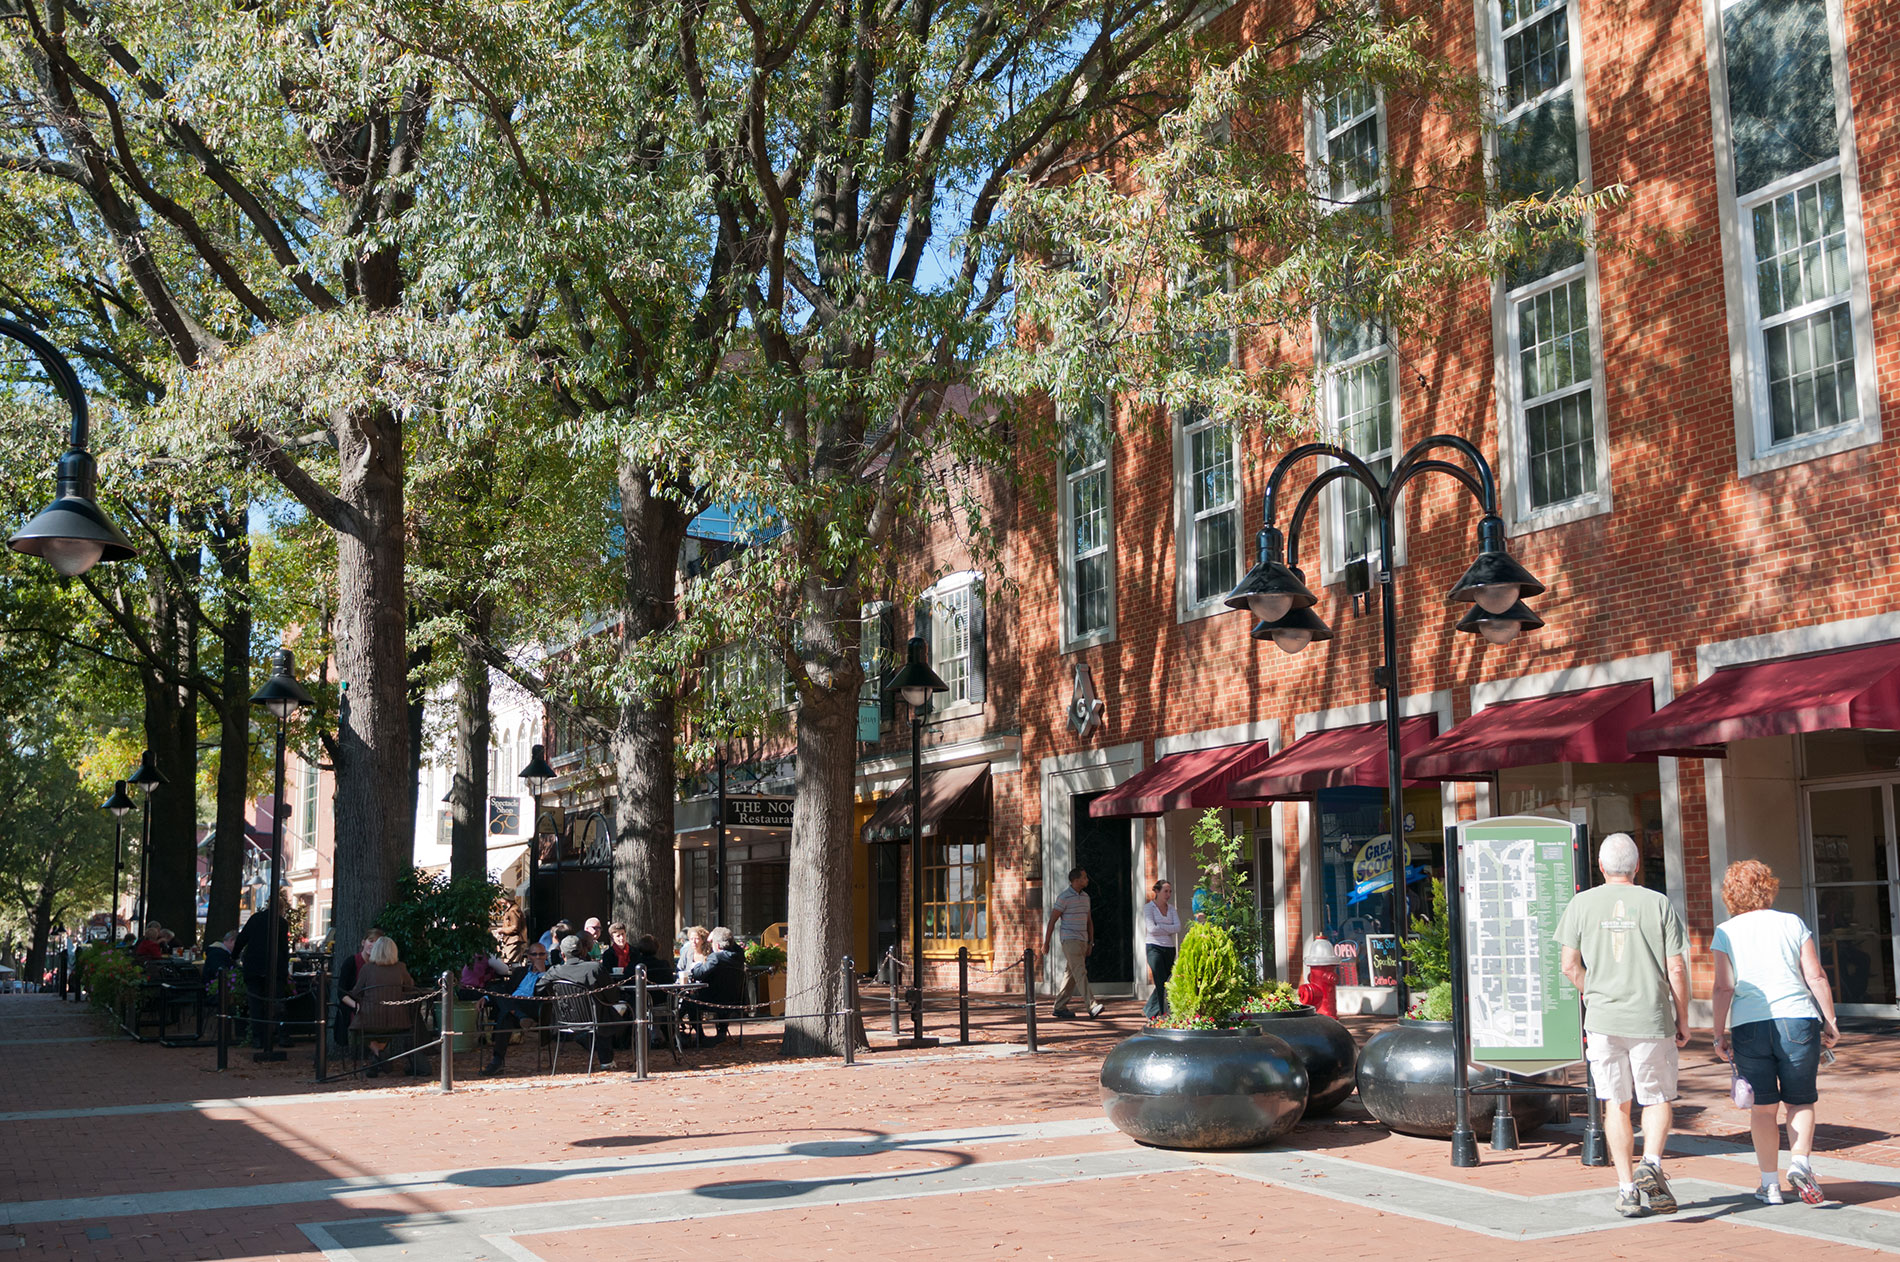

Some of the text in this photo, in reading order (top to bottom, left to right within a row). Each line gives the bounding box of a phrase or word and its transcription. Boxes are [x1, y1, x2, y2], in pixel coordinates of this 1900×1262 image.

[490, 797, 519, 808] Spectacle
[732, 801, 795, 814] THE NO
[496, 804, 514, 815] Shop
[739, 812, 794, 824] Restaura
[1365, 840, 1393, 861] GREA
[1334, 943, 1357, 958] OPEN
